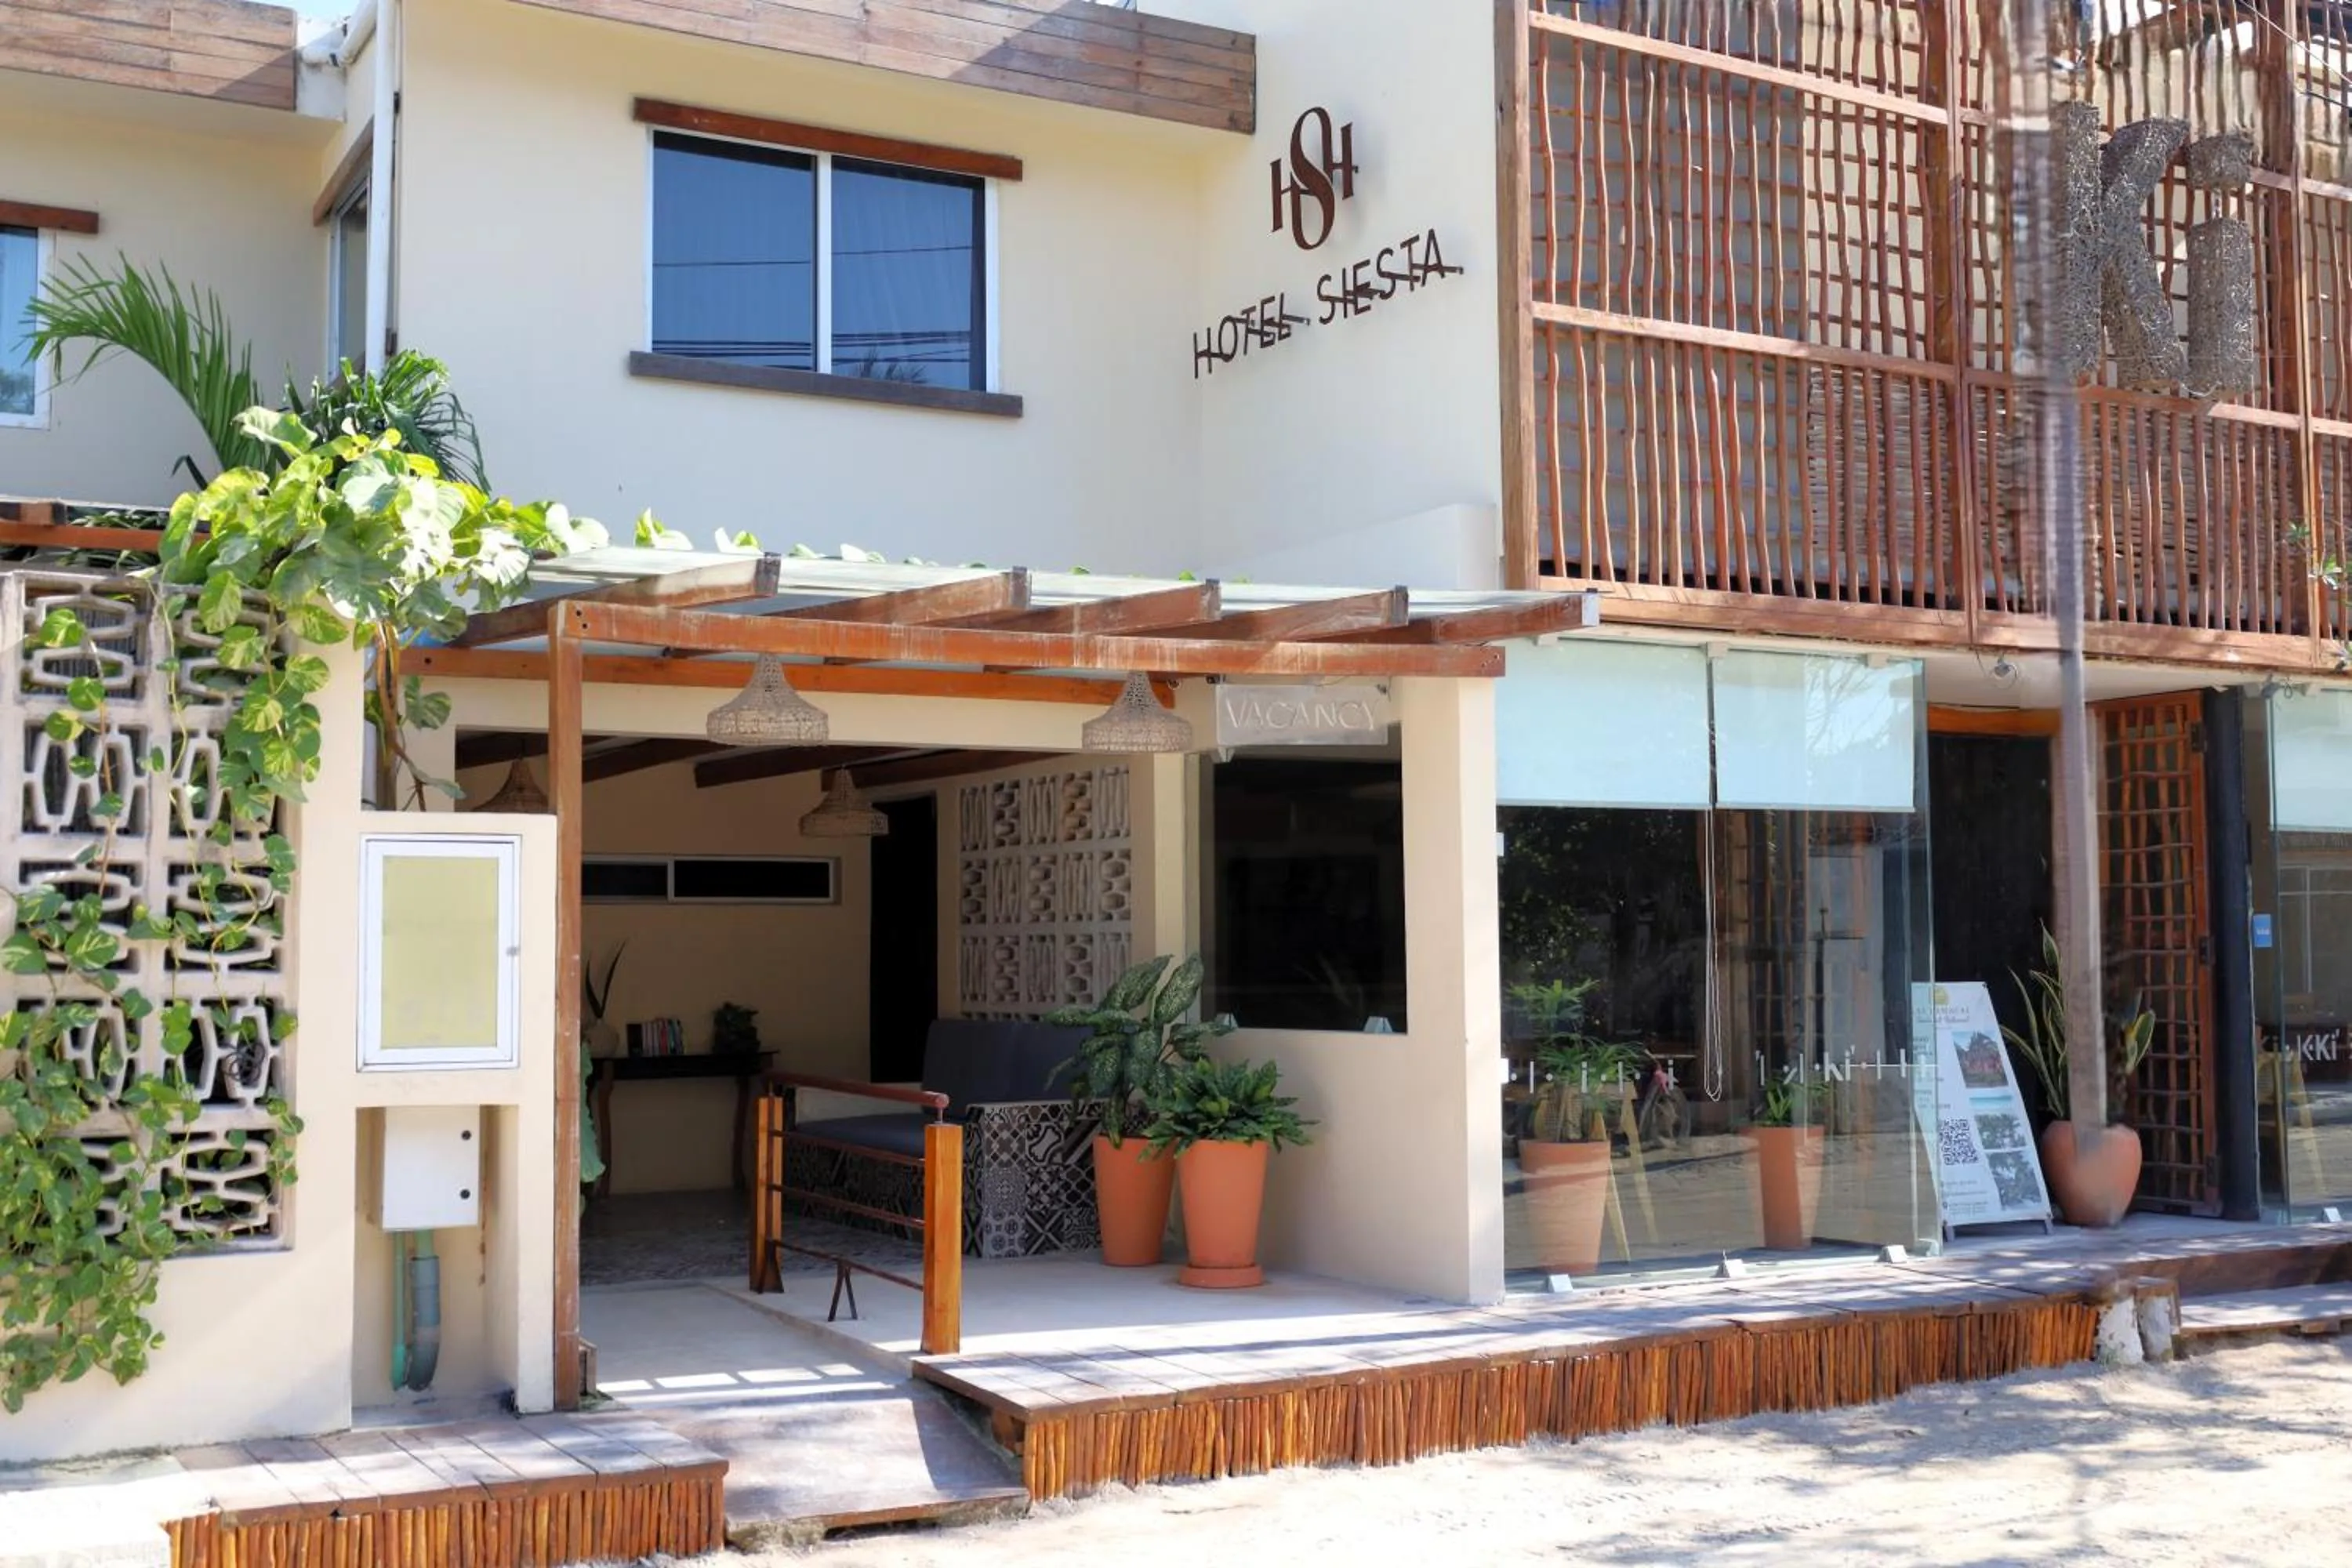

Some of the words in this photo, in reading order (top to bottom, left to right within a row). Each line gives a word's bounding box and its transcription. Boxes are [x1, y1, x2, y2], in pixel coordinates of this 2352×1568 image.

[1192, 292, 1294, 379] HOTEL
[1316, 227, 1447, 325] SIESTA
[1225, 697, 1381, 731] VACANCY
